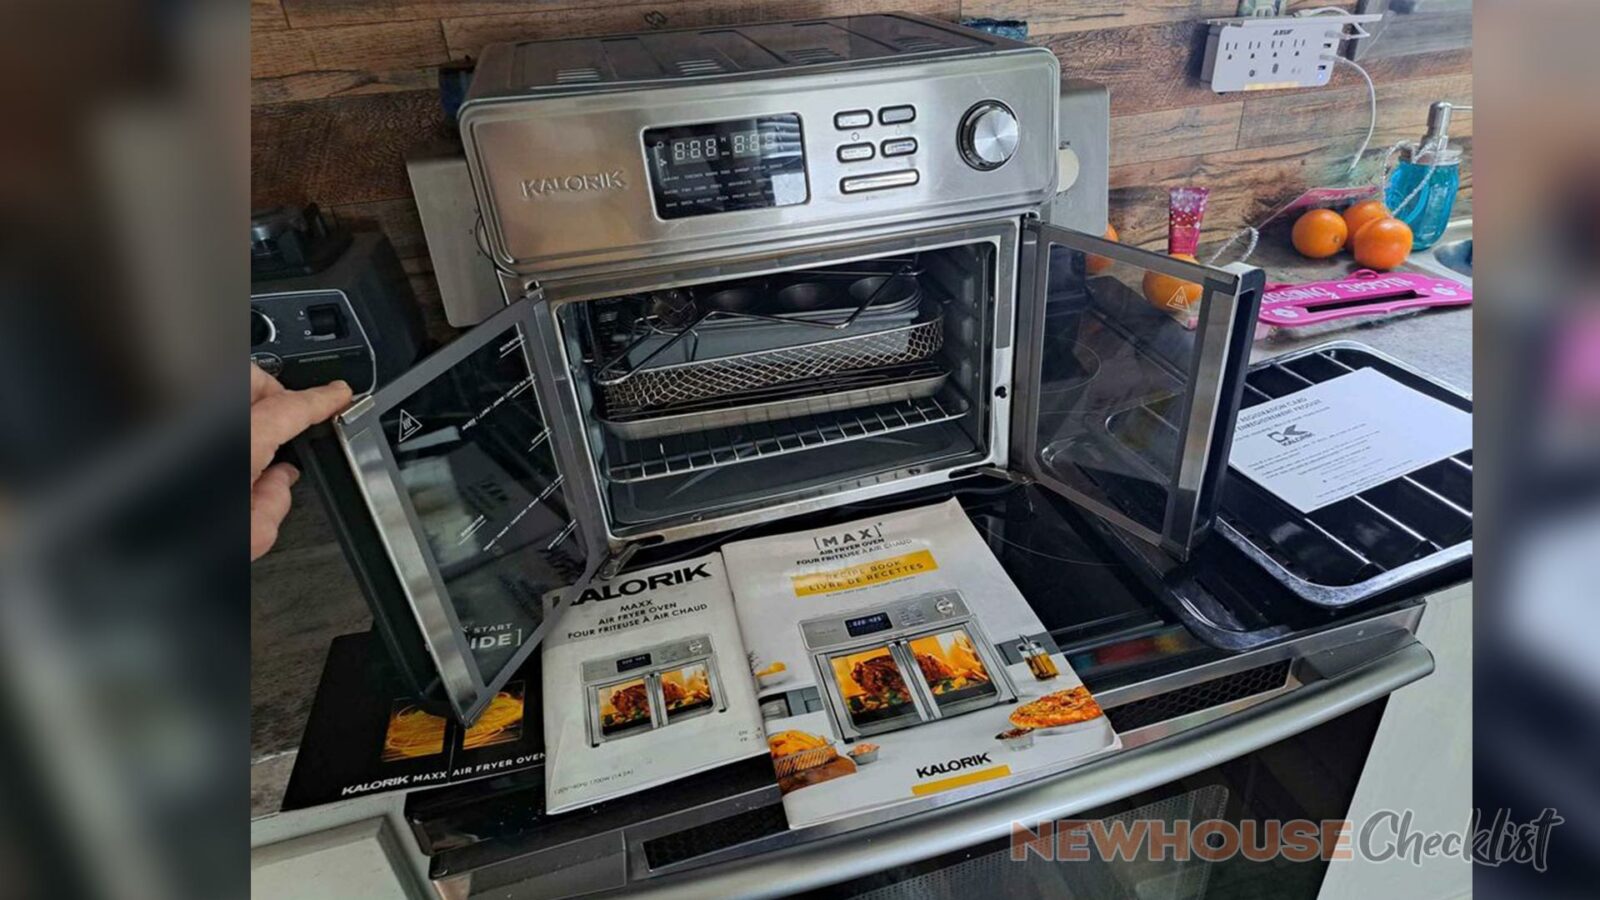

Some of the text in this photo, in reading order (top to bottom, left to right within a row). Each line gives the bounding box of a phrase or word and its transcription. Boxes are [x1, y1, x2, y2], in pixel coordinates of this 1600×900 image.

[521, 169, 627, 199] KALORIK
[819, 538, 885, 556] AIR FRYER OVEN
[821, 551, 861, 563] FRITEUSE
[869, 544, 883, 553] AIR
[884, 538, 912, 550] CHAUD
[808, 580, 843, 592] LIVRE
[848, 576, 861, 585] DE
[867, 562, 925, 580] RECETTES
[870, 560, 901, 571] BOOK
[553, 562, 712, 608] ALORIK
[598, 602, 677, 626] AIR FRYER OVEN
[598, 618, 640, 634] FRITEUSE
[653, 612, 670, 622] AIR
[672, 603, 709, 617] CHAUD
[620, 599, 654, 612] MAXX
[473, 622, 513, 634] START
[341, 752, 545, 796] KALORIK MAXX AIR FRYER OVEN
[916, 752, 992, 779] KALORIK
